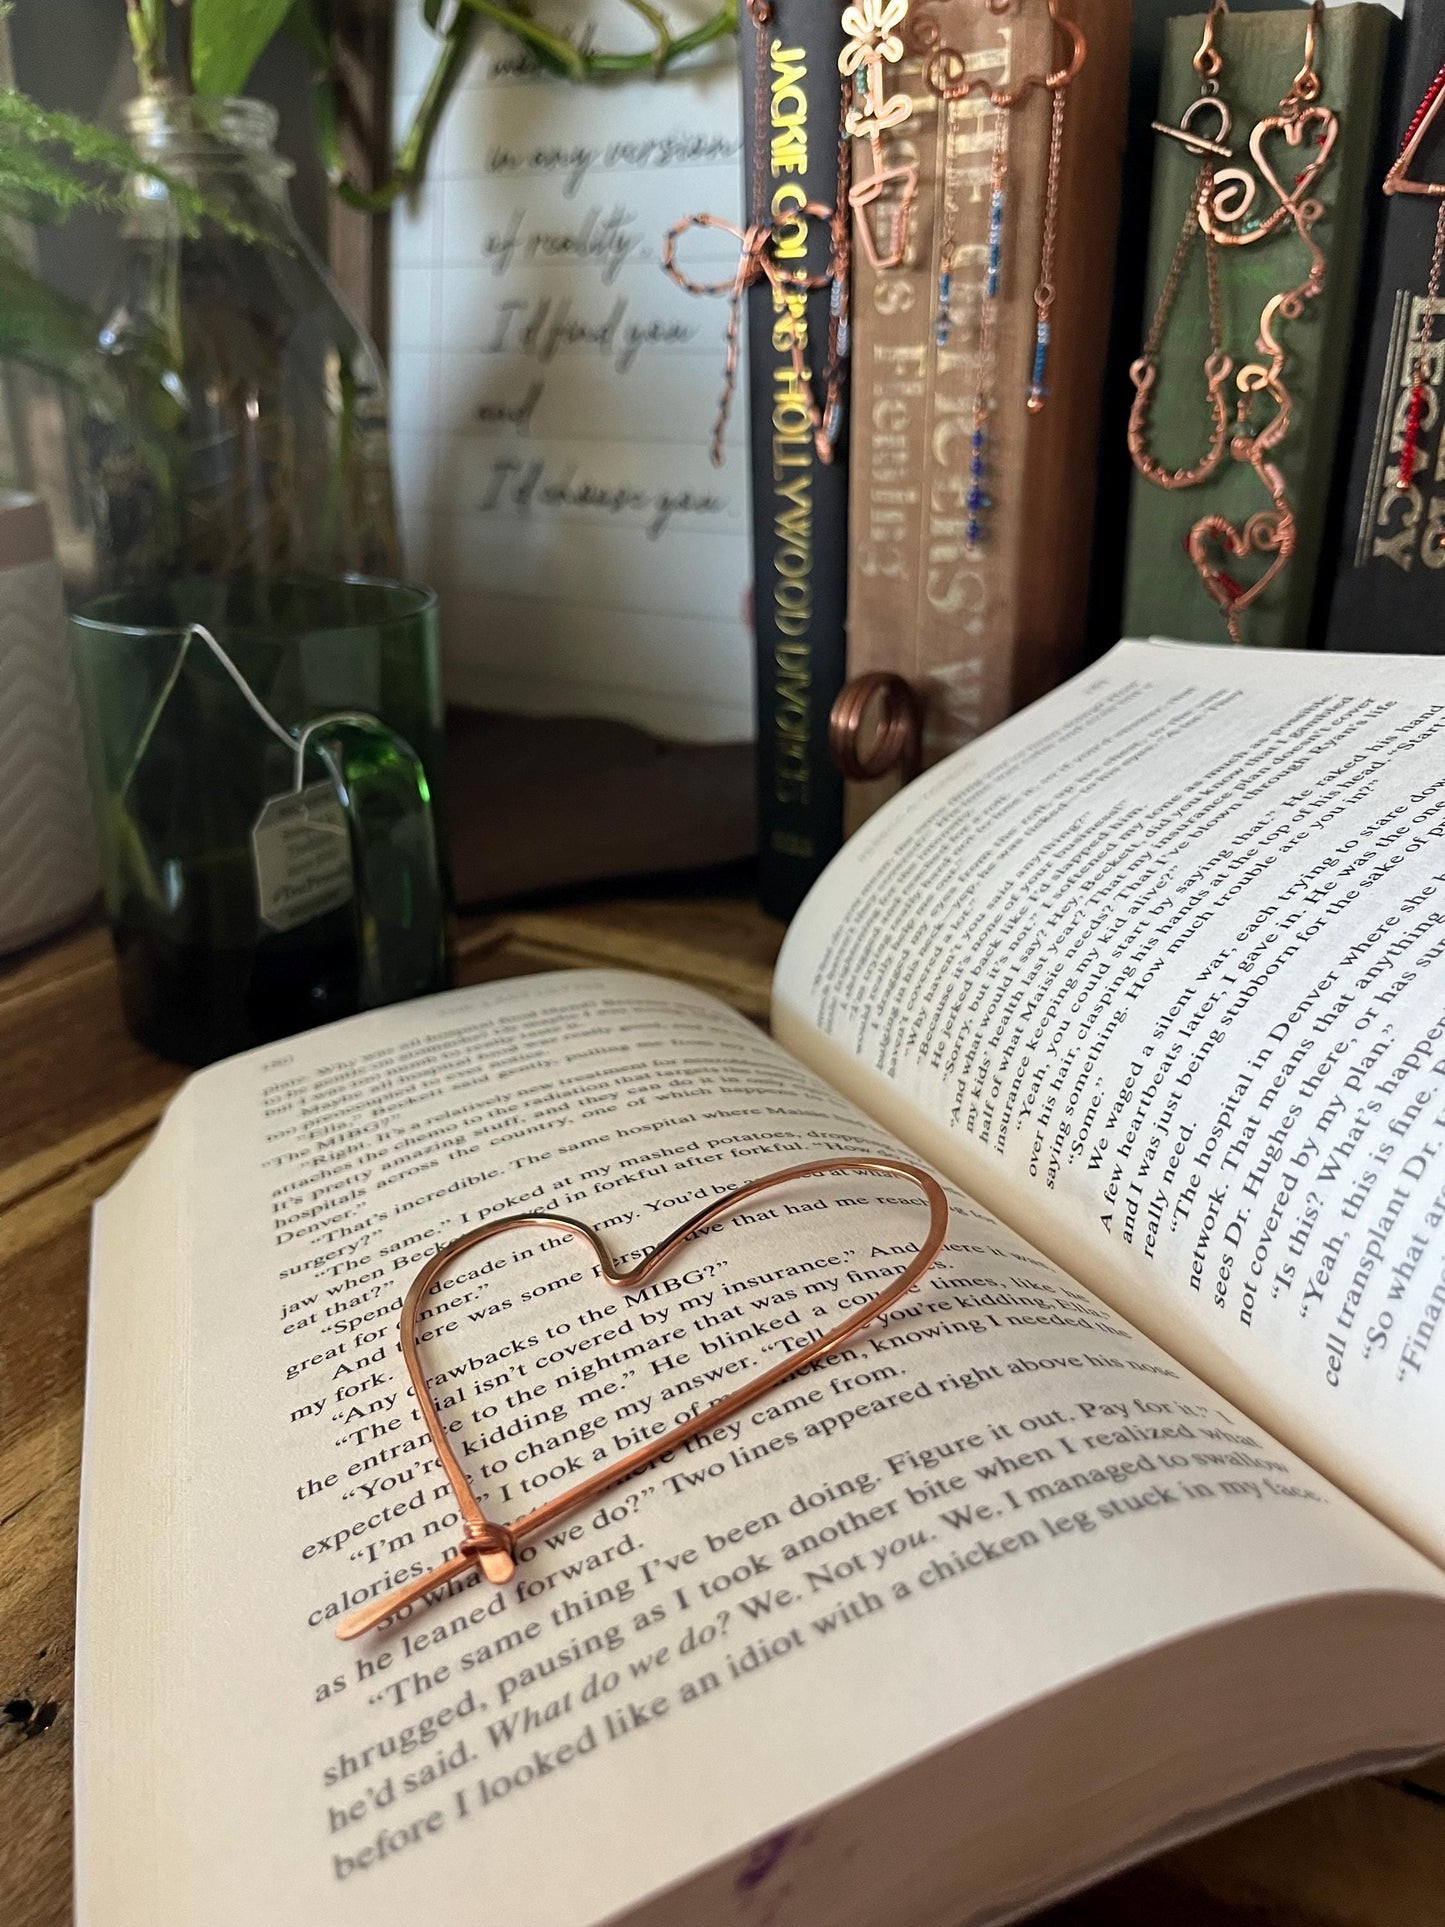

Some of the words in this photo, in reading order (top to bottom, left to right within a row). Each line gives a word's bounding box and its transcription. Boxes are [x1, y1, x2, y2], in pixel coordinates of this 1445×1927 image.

[770, 38, 807, 176] JACKIE
[773, 365, 813, 636] HOLLYWOOD
[1291, 808, 1313, 823] of
[1307, 790, 1342, 808] his
[1227, 848, 1259, 870] the
[1257, 824, 1291, 846] top
[1210, 873, 1230, 888] at
[1154, 890, 1211, 935] hands
[1274, 909, 1308, 930] in.
[1129, 938, 1160, 963] his
[1220, 974, 1238, 985] I
[1237, 933, 1279, 973] gave
[1077, 965, 1137, 1041] clasping
[1087, 1137, 1109, 1170] We
[1104, 1061, 1144, 1129] waged
[1152, 988, 1198, 1040] silent
[1195, 947, 1238, 981] war,
[1235, 905, 1280, 942] each
[1277, 856, 1341, 901] trying
[1334, 839, 1360, 854] to
[1359, 805, 1409, 838] stare
[1177, 990, 1228, 1039] later,
[1372, 971, 1418, 1005] has
[1354, 1006, 1379, 1031] or
[1049, 1045, 1083, 1092] hair,
[1170, 1173, 1201, 1233] “The
[1193, 1073, 1254, 1169] hospital
[1246, 1048, 1274, 1071] in
[1267, 970, 1340, 1043] Denver
[1338, 916, 1401, 966] where
[1399, 886, 1438, 914] she
[1298, 1037, 1358, 1099] there,
[1036, 1096, 1057, 1127] his
[1116, 1044, 1184, 1159] heartbeats
[1189, 1184, 1230, 1293] network.
[1219, 1116, 1262, 1171] That
[1258, 1040, 1316, 1111] means
[1312, 993, 1356, 1033] that
[1354, 911, 1445, 990] anything
[1029, 1129, 1045, 1178] over
[1239, 1280, 1258, 1328] not
[1250, 1171, 1299, 1277] covered
[1289, 1136, 1320, 1168] by
[1315, 1093, 1347, 1134] my
[1343, 1023, 1396, 1093] plan.”
[1241, 1104, 1303, 1199] Hughes
[379, 1218, 451, 1257] same.”
[459, 1212, 471, 1225] I
[477, 1184, 545, 1221] poked
[552, 1177, 572, 1190] at
[579, 1164, 610, 1180] my
[618, 1140, 700, 1168] mashed
[1103, 1162, 1124, 1206] few
[1271, 1262, 1296, 1300] “Is
[1287, 1191, 1324, 1257] this?
[1316, 1100, 1383, 1181] What’s
[1300, 1231, 1351, 1319] “Yeah,
[1340, 1170, 1378, 1220] this
[1368, 1144, 1395, 1166] is
[1387, 1087, 1439, 1138] fine.
[1099, 1213, 1114, 1235] A
[1223, 1208, 1252, 1249] Dr.
[1214, 1253, 1234, 1309] sees
[1325, 1332, 1347, 1388] cell
[1336, 1187, 1411, 1330] transplant
[1400, 1141, 1443, 1182] Dr.
[334, 1418, 403, 1447] “The
[473, 1363, 528, 1396] isn’t
[535, 1318, 635, 1369] covered
[638, 1307, 669, 1326] by
[677, 1291, 714, 1313] my
[721, 1249, 856, 1296] insurance.”
[870, 1241, 920, 1258] And
[368, 1665, 451, 1707] “The
[460, 1621, 542, 1672] same
[550, 1578, 636, 1628] thing
[639, 1548, 699, 1585] I’ve
[703, 1511, 782, 1554] been
[788, 1472, 882, 1517] doing.
[883, 1434, 985, 1476] Figure
[986, 1423, 1014, 1442] it
[1018, 1409, 1076, 1432] out.
[1076, 1402, 1130, 1419] Pay
[315, 1674, 347, 1704] as
[355, 1652, 393, 1683] he
[401, 1591, 507, 1659] leaned
[514, 1533, 644, 1605] forward.
[323, 1689, 488, 1788] shrugged,
[496, 1625, 626, 1706] pausing
[632, 1604, 667, 1633] as
[674, 1587, 691, 1611] I
[698, 1553, 773, 1599] took
[780, 1498, 899, 1562] another
[904, 1475, 967, 1506] bite
[973, 1447, 1056, 1481] when
[1057, 1436, 1078, 1455] I
[1081, 1423, 1198, 1450] realized
[327, 1776, 397, 1835] he’d
[402, 1739, 478, 1795] said.
[486, 1691, 573, 1749] What
[580, 1671, 621, 1705] do
[628, 1646, 670, 1679] we
[678, 1610, 731, 1657] do?
[738, 1589, 803, 1620] We.
[802, 1554, 868, 1594] Not
[871, 1529, 937, 1571] you.
[938, 1504, 1003, 1530] We.
[1003, 1489, 1023, 1511] I
[1025, 1453, 1158, 1504] managed
[1156, 1453, 1190, 1469] to
[332, 1810, 444, 1882] before
[455, 1790, 470, 1820] I
[477, 1724, 599, 1808] looked
[603, 1696, 670, 1742] like
[678, 1671, 722, 1705] an
[725, 1628, 806, 1681] idiot
[810, 1591, 886, 1636] with
[891, 1581, 913, 1602] a
[917, 1529, 1041, 1589] chicken
[1039, 1511, 1098, 1539] leg
[1096, 1485, 1180, 1520] stuck
[1181, 1483, 1217, 1500] in
